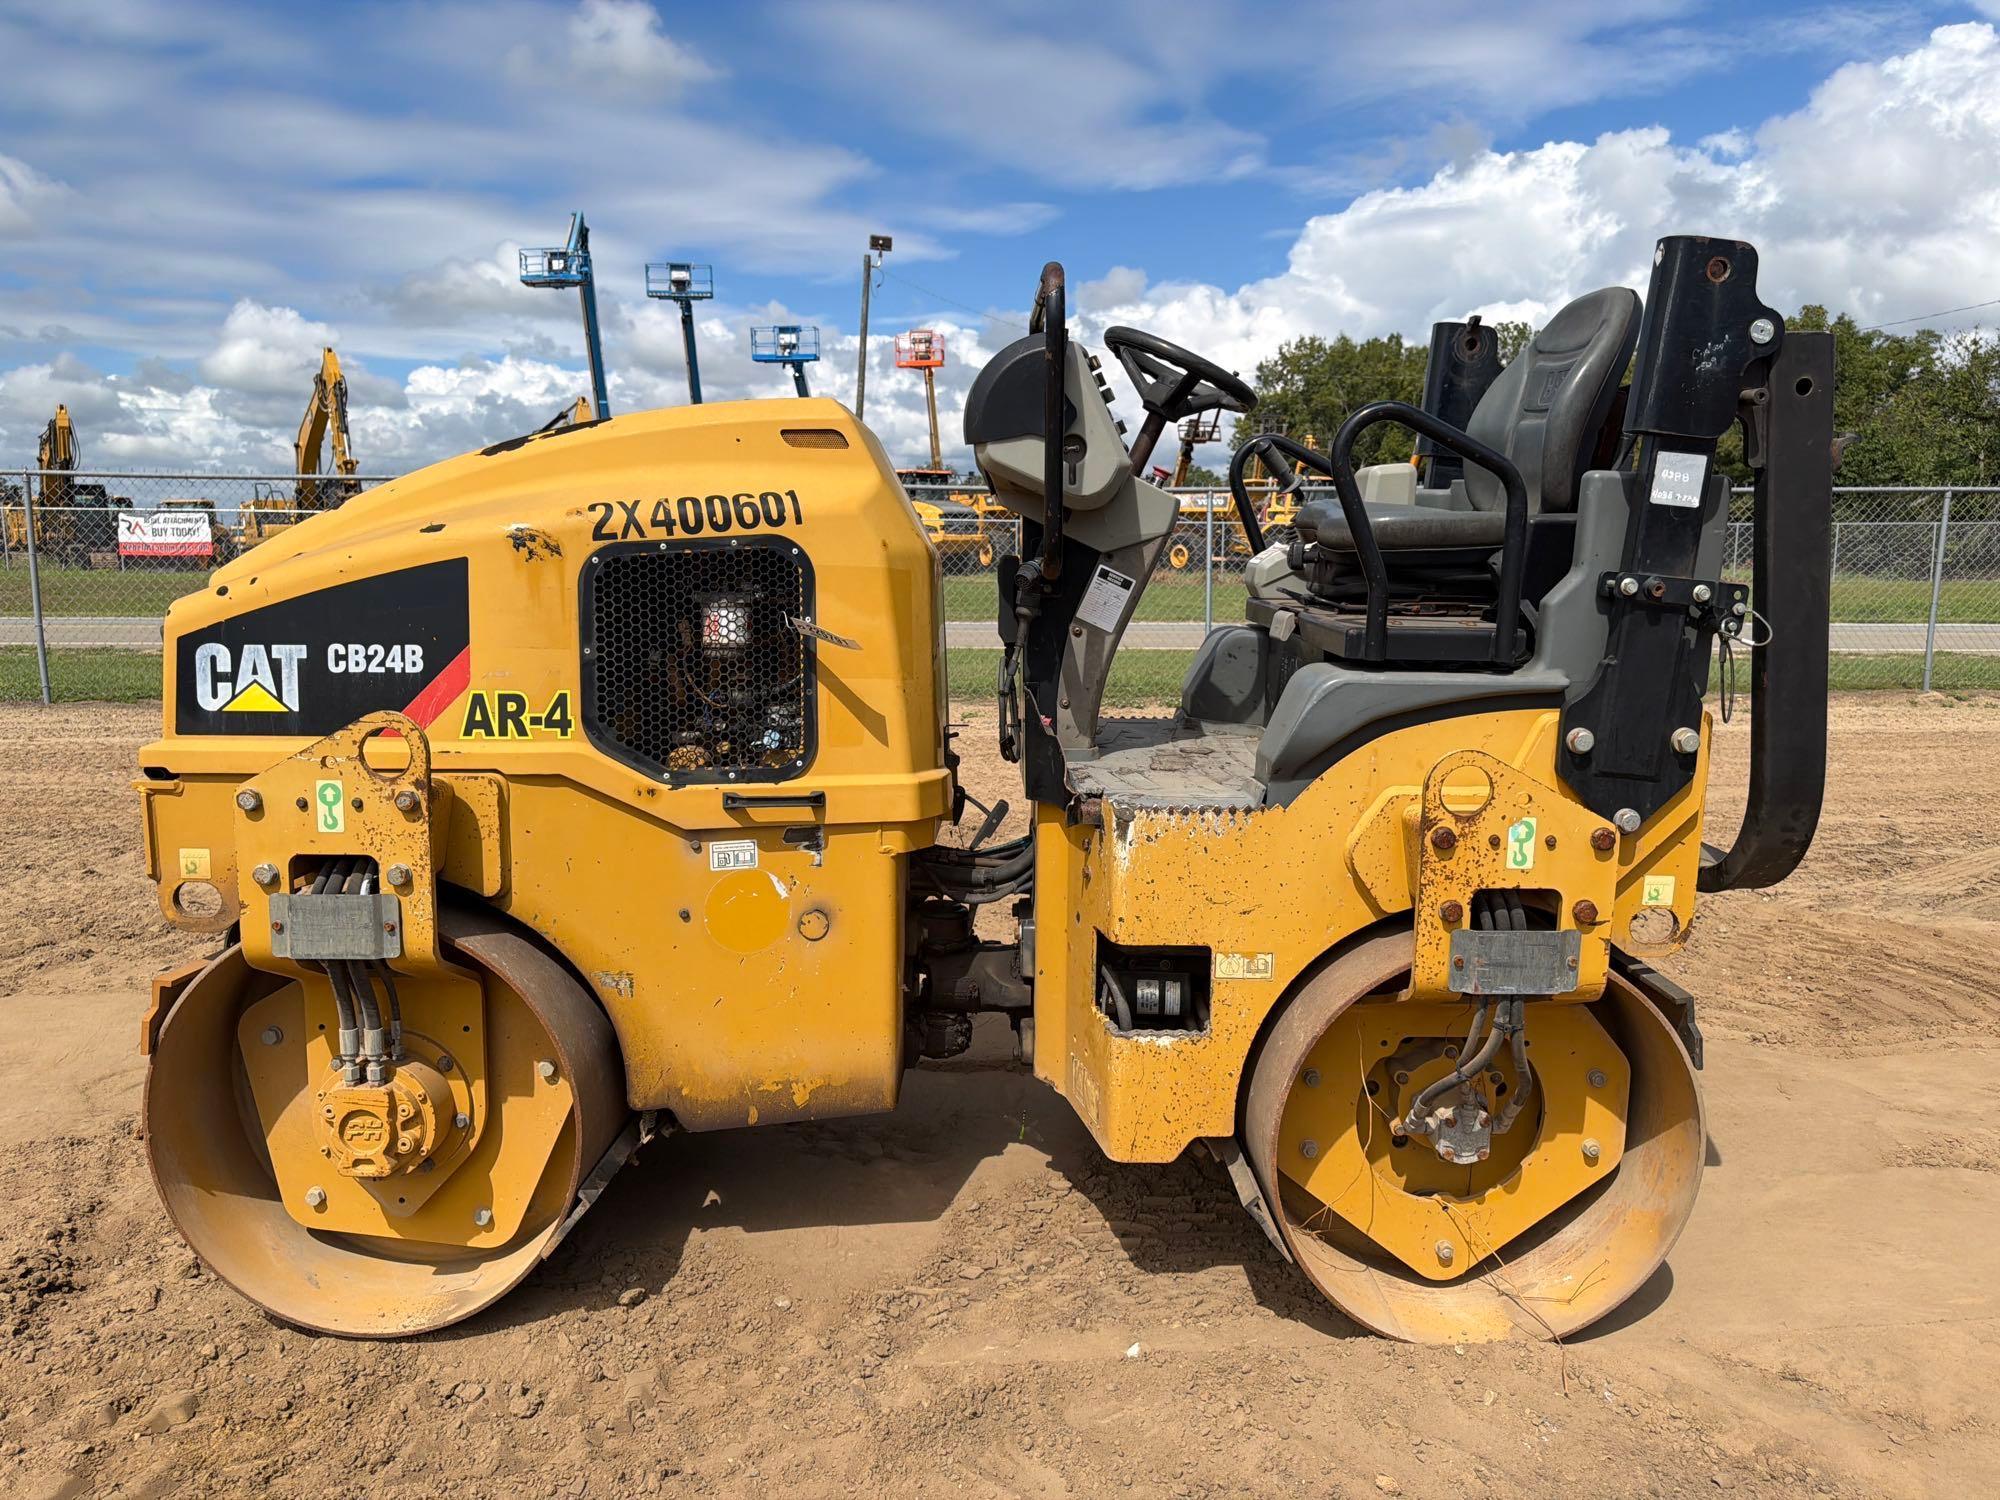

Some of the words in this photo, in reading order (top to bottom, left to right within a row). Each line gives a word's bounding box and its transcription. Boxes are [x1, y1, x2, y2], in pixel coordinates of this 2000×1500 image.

[151, 527, 168, 537] BUY
[171, 527, 200, 537] TODAY!
[588, 490, 803, 541] 2X400601
[195, 642, 307, 712] CAT
[327, 643, 424, 674] CB24B
[459, 689, 576, 740] AR-4
